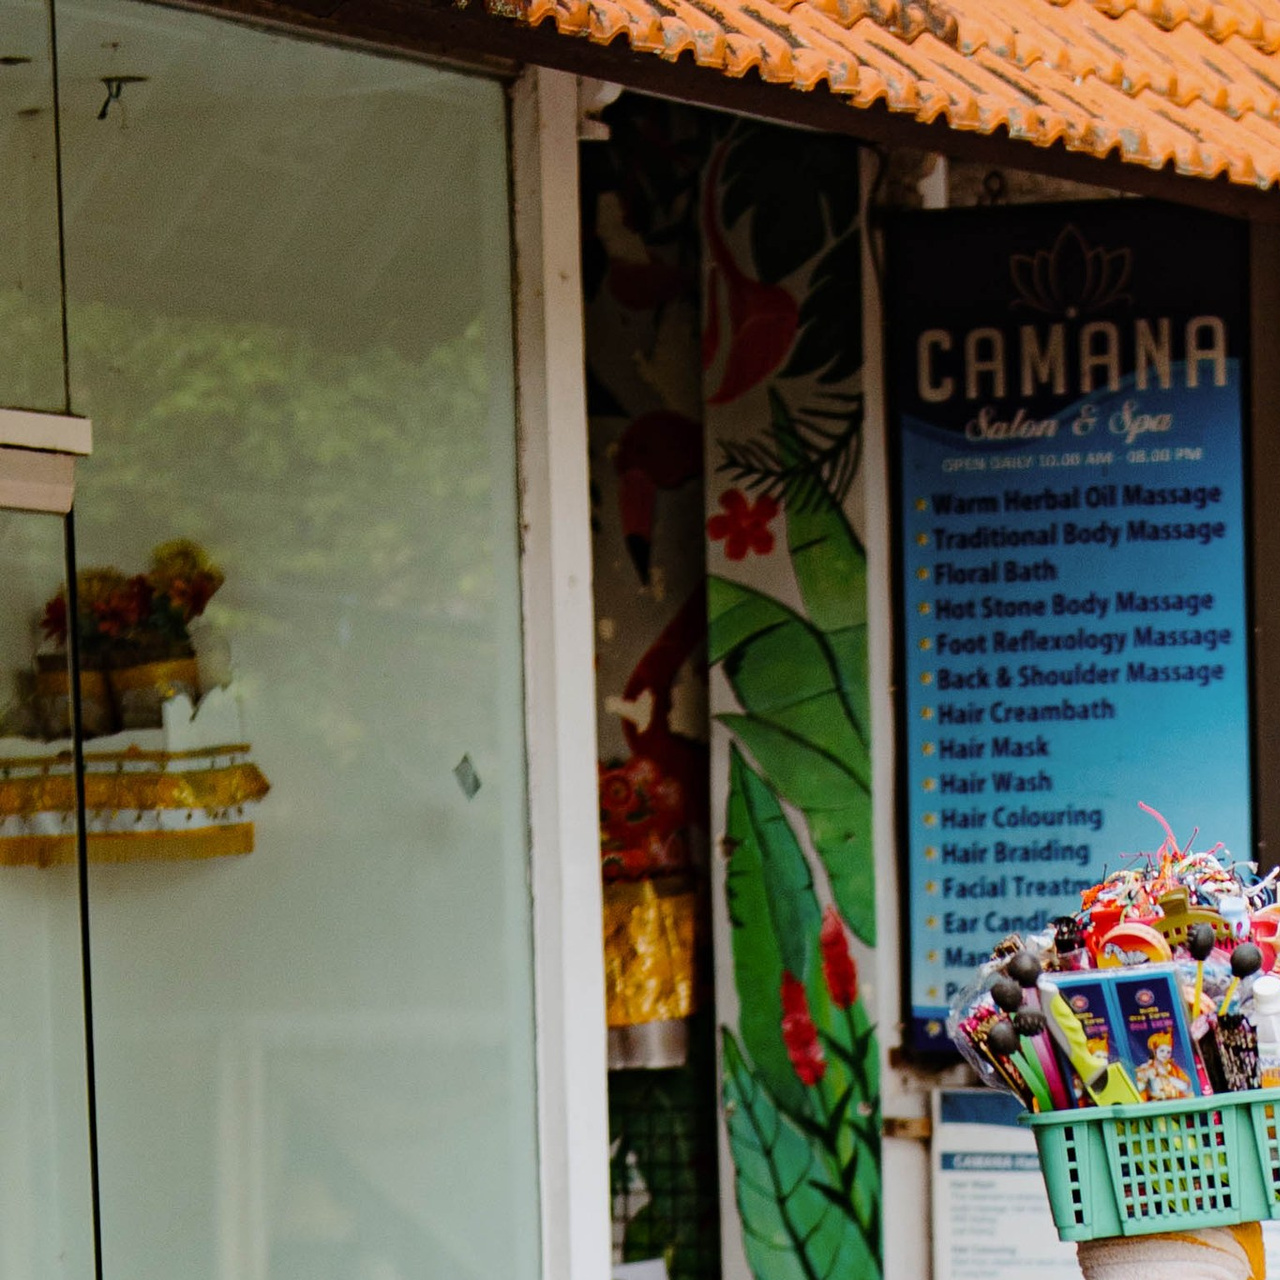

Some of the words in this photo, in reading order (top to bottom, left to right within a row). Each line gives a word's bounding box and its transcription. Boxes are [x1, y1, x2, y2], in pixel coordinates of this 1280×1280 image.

[917, 316, 1226, 402] CAMANA
[965, 403, 1058, 441] Salon
[1071, 404, 1097, 436] &
[1108, 399, 1173, 444] Spa
[932, 492, 998, 515] Warm
[1004, 486, 1080, 511] Herbal
[1084, 484, 1118, 508] Oil
[1122, 484, 1222, 510] Massage
[933, 522, 1057, 549] Traditional
[1063, 520, 1121, 548] Body
[1126, 519, 1226, 545] Massage
[934, 561, 997, 585] Floral
[1004, 558, 1058, 582] Bath
[935, 599, 975, 620] Hot
[981, 595, 1046, 619] Stone
[1052, 592, 1108, 619] Body
[1115, 590, 1214, 616] Massage
[936, 632, 987, 656] Foot
[992, 628, 1128, 655] Reflexology
[1133, 626, 1232, 651] Massage
[937, 666, 990, 690] Back
[995, 665, 1012, 688] &
[1017, 662, 1120, 687] Shoulder
[1127, 661, 1225, 686] Massage
[938, 701, 985, 725] Hair
[990, 698, 1115, 723] Creambath
[939, 736, 985, 759] Hair
[991, 735, 1049, 758] Mask
[940, 773, 986, 794] Hair
[992, 769, 1053, 792] Wash
[941, 808, 987, 829] Hair
[992, 804, 1105, 830] Colouring
[942, 842, 988, 864] Hair
[994, 838, 1091, 865] Braiding
[943, 876, 1007, 899] Facial
[1013, 876, 1090, 898] Treatm
[944, 912, 979, 934] Ear
